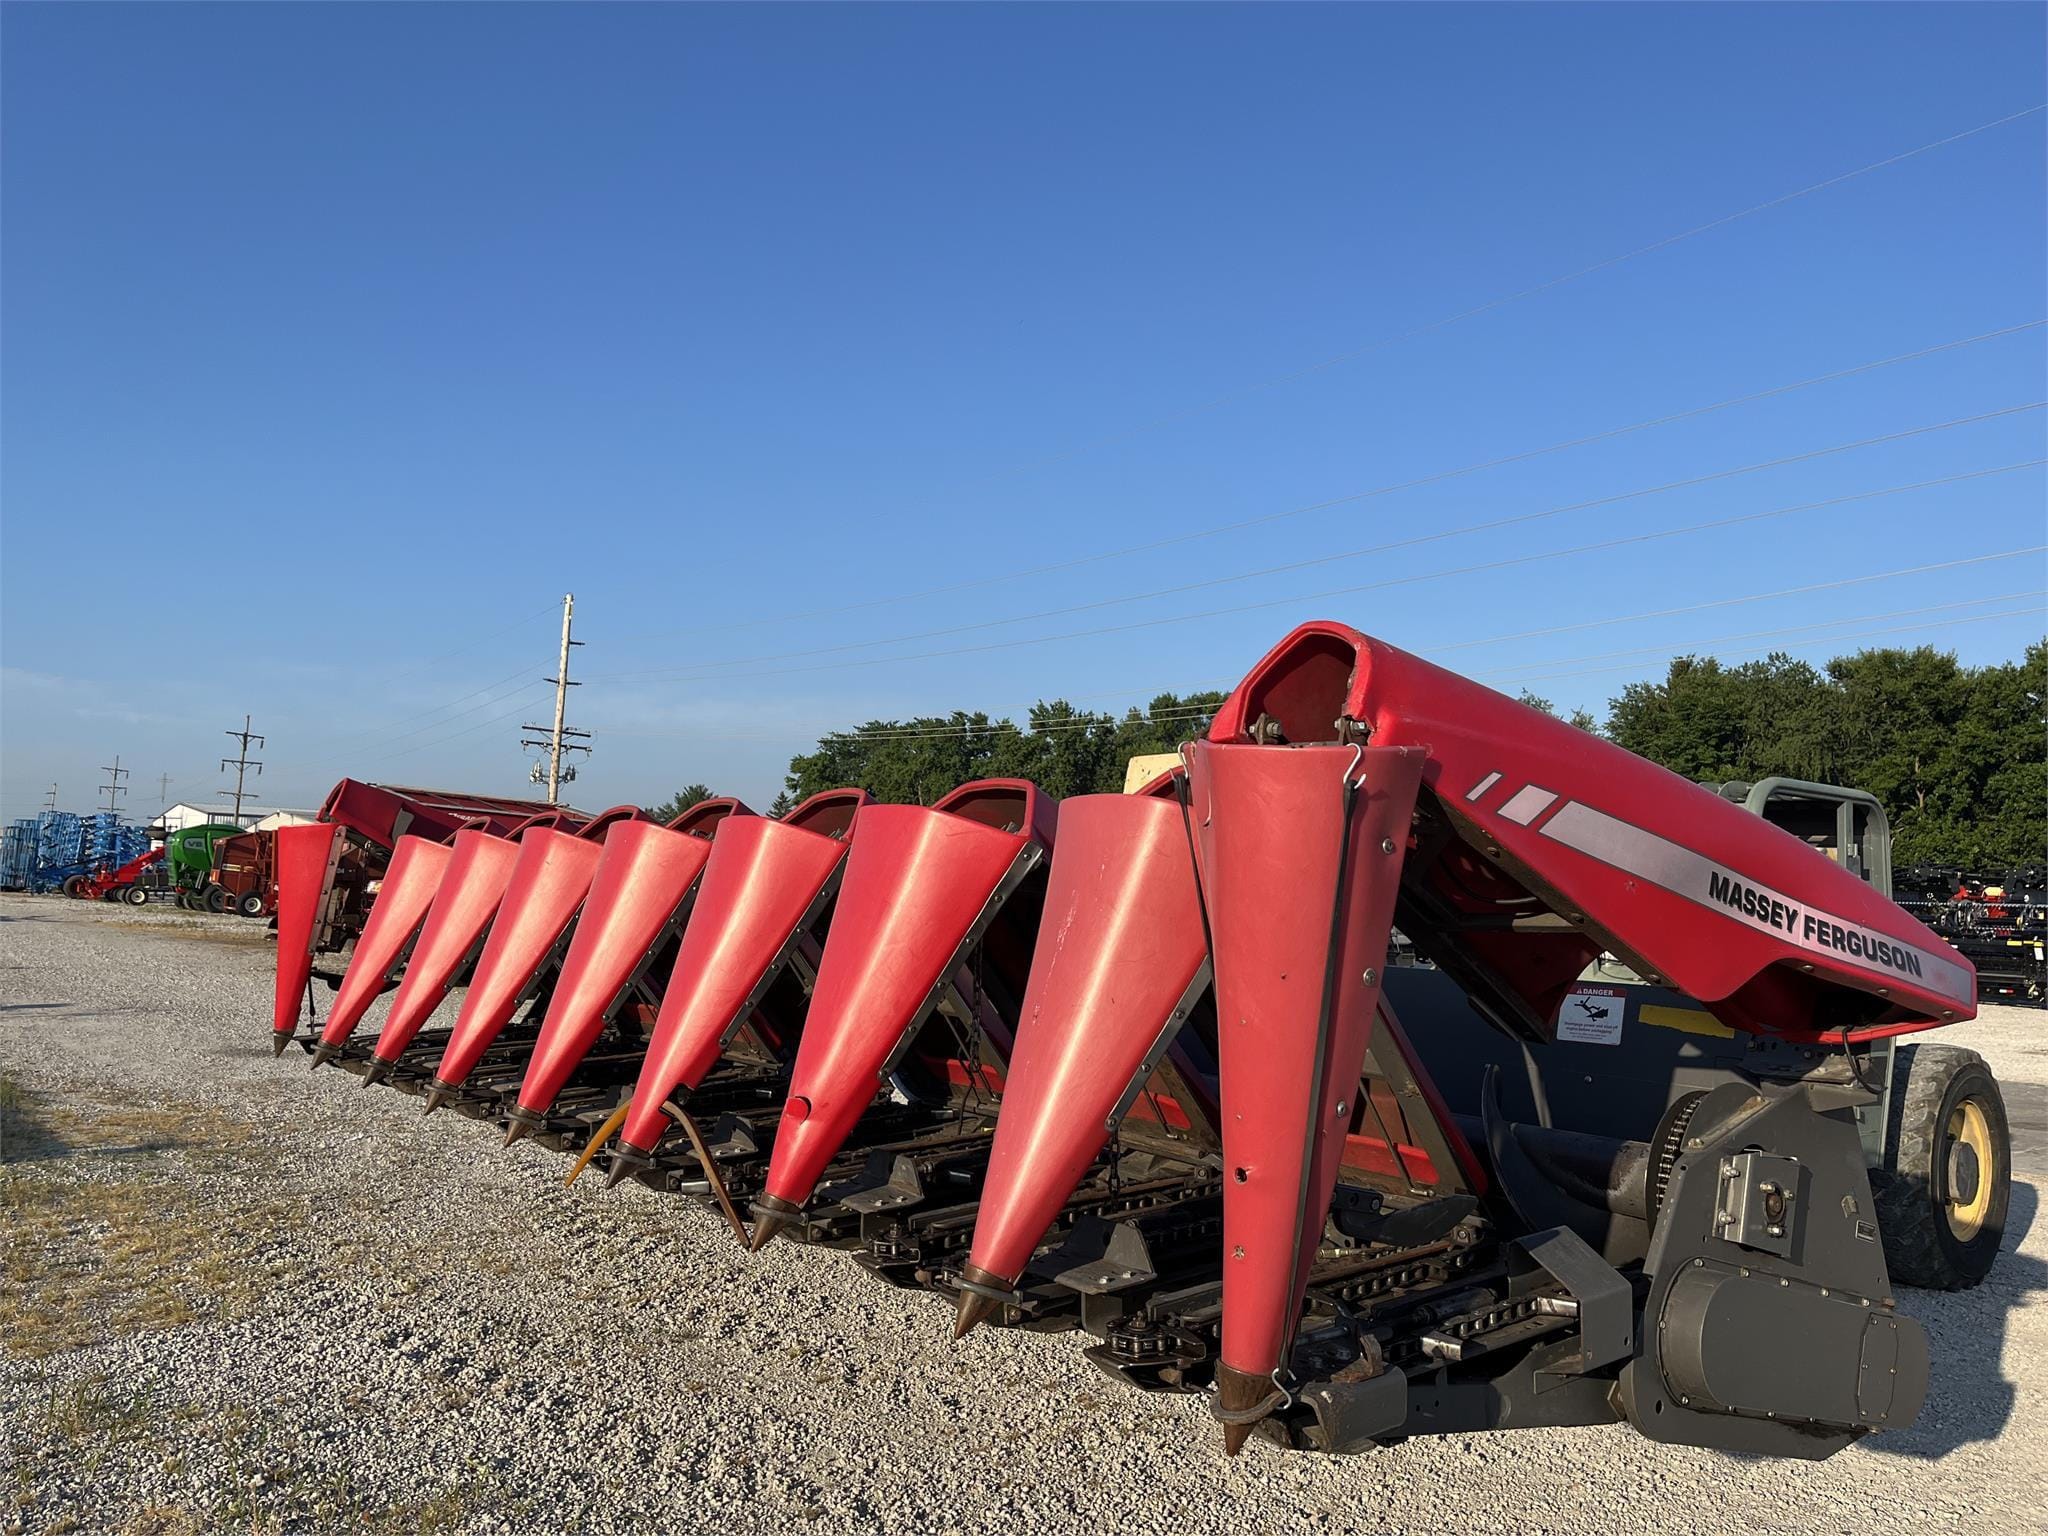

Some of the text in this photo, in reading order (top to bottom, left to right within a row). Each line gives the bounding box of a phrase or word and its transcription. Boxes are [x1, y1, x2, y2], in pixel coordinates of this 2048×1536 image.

[1709, 871, 1923, 978] MASSEY FERGUSON
[1583, 988, 1614, 996] DANGER
